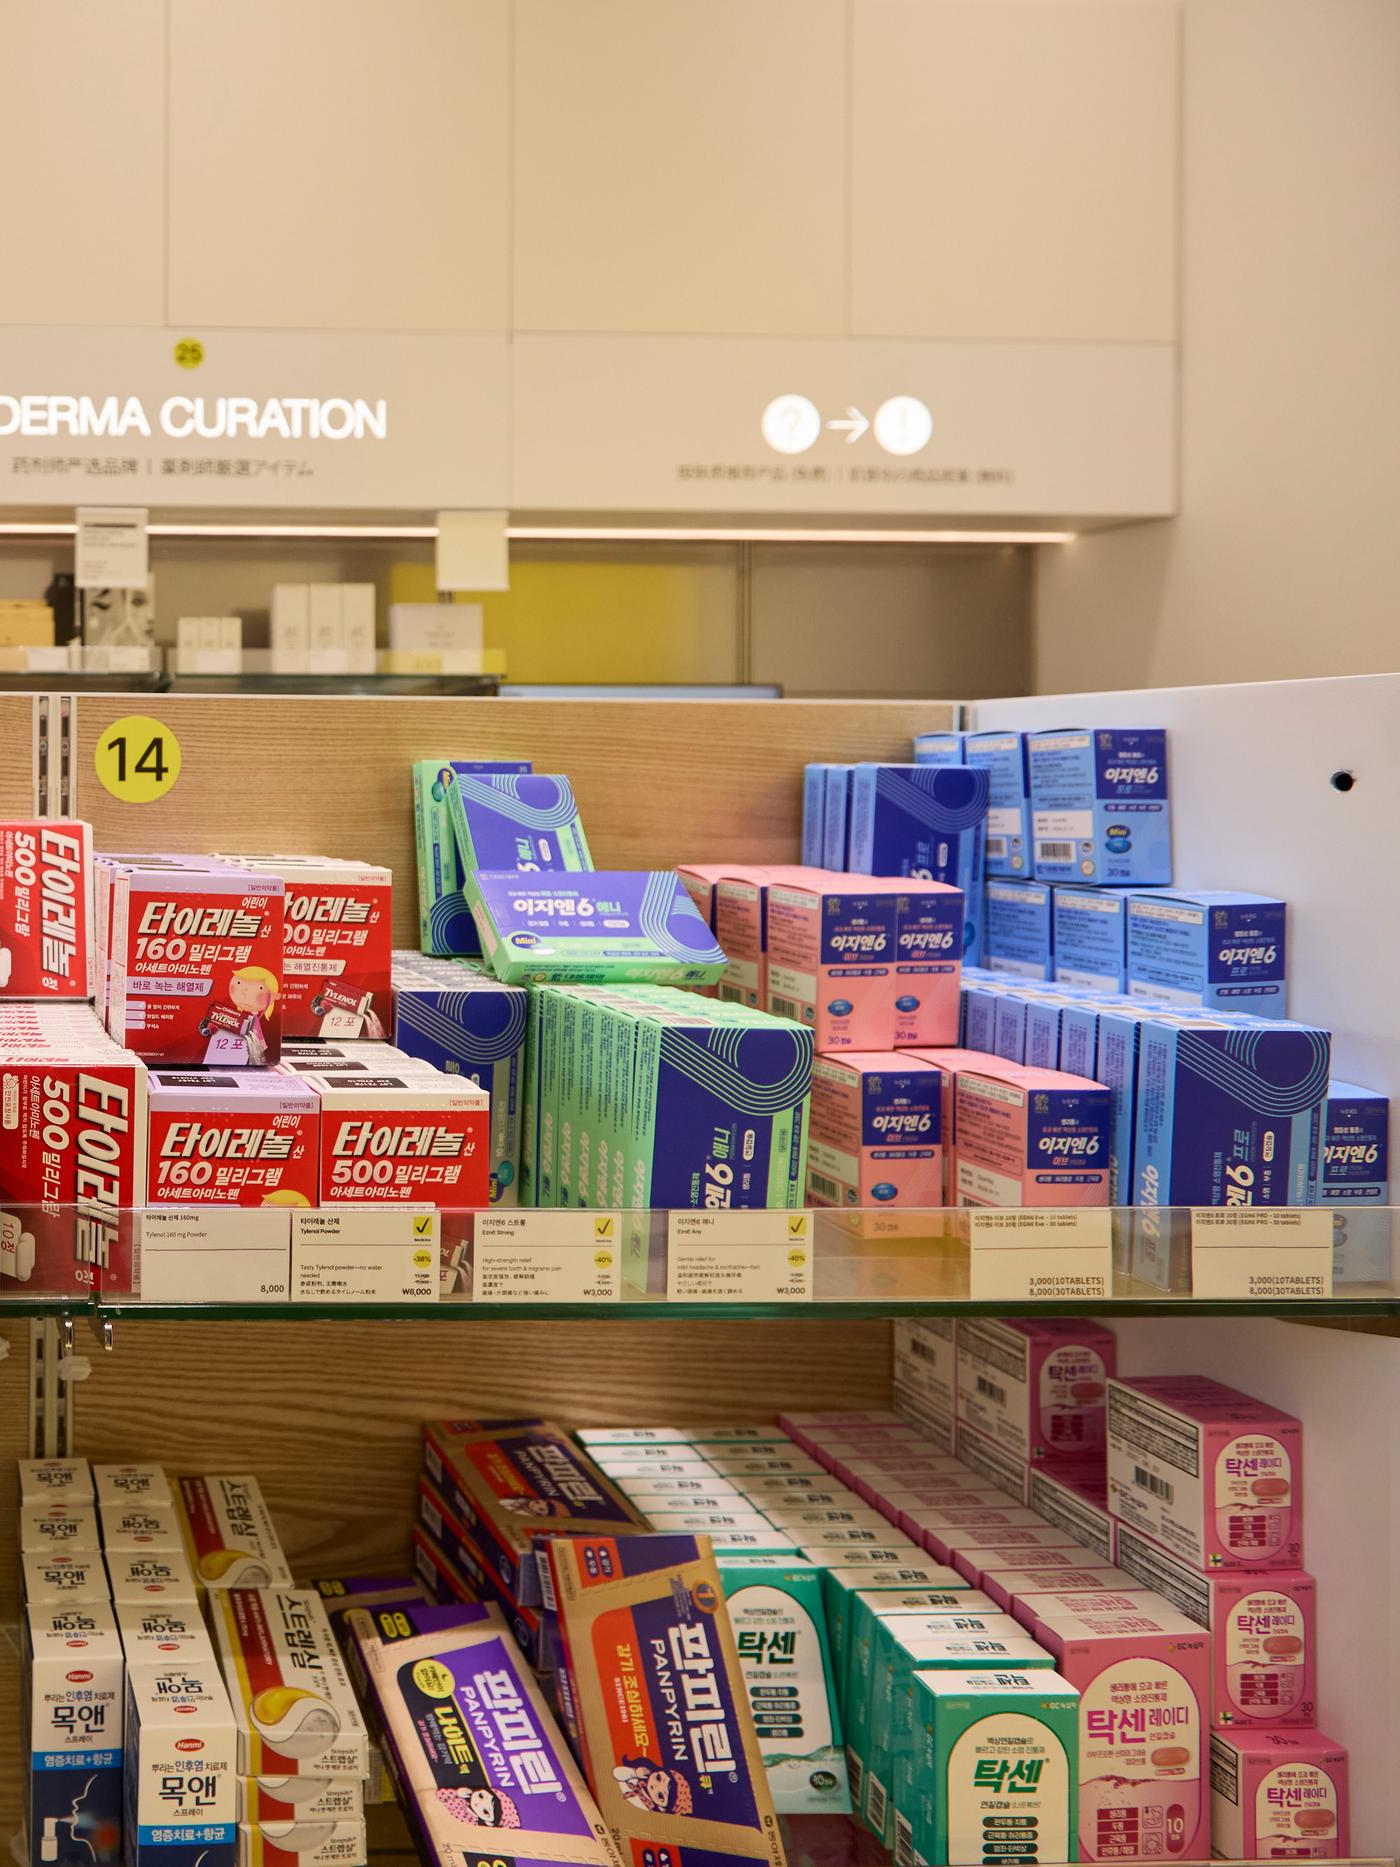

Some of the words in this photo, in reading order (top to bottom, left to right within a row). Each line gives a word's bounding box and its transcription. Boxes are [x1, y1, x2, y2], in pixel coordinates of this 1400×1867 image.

[160, 397, 387, 439] CURATION
[107, 737, 169, 782] 14
[13, 830, 37, 887] 500
[40, 829, 80, 978] 타이레놀
[241, 896, 268, 909] 어린이
[514, 897, 594, 917] 이지엔6
[137, 901, 262, 938] 타이레놀
[311, 928, 369, 947] 밀리그램
[830, 932, 887, 952] 이지엔6
[900, 930, 954, 950] 이지엔6
[134, 938, 187, 961] 160
[189, 944, 252, 964] 밀리그램
[1218, 945, 1277, 966] 이지엔6
[134, 962, 211, 975] 아세트아미노펜
[132, 980, 151, 991] 바로
[155, 980, 174, 992] 녹는
[176, 980, 204, 993] 해열제
[323, 988, 358, 1007] TYLENOL
[41, 1075, 71, 1150] 500
[272, 1115, 301, 1128] 어린이
[872, 1113, 932, 1133] 이지엔6
[161, 1121, 291, 1160] 타이레놀
[332, 1121, 465, 1159] 타이레놀
[1038, 1135, 1100, 1155] 이지엔6
[75, 1073, 128, 1268] 타이레놀
[156, 1160, 213, 1186] 160
[215, 1166, 282, 1187] 밀리그램
[331, 1159, 393, 1186] 500
[395, 1164, 463, 1185] 밀리그램
[40, 1151, 62, 1219] 밀리그람
[156, 1186, 240, 1201] 아세트아미노펜
[329, 1185, 413, 1200] 아세트아미노펜
[300, 1217, 325, 1225] 타이레놀
[146, 1231, 164, 1239] Tylenol
[260, 1284, 285, 1294] 8,000
[402, 1287, 432, 1297] ₩8,000
[583, 1288, 613, 1297] ₩3,000
[776, 1287, 806, 1296] ₩3,000
[276, 1594, 322, 1671] 스트렙실
[1237, 1615, 1271, 1635] 탁센
[738, 1631, 798, 1664] 탁센
[65, 1690, 93, 1702] 인후염
[649, 1639, 688, 1762] PANPYRIN
[669, 1622, 736, 1774] 판피린
[51, 1705, 106, 1735] 목앤
[1086, 1709, 1147, 1745] 탁센
[1148, 1706, 1190, 1727] 레이디
[433, 1705, 474, 1765] 나이트
[459, 1685, 515, 1790] PANPYRIN
[473, 1669, 563, 1796] 판피린
[44, 1753, 114, 1767] 염증치료+항균
[175, 1759, 204, 1773] 인후염
[973, 1759, 1044, 1794] 탁센
[158, 1775, 217, 1807] 목앤
[1266, 1786, 1303, 1808] 탁센
[172, 1807, 204, 1817] 스프레이
[1166, 1816, 1184, 1834] 10
[151, 1828, 226, 1843] 염증치료+항균
